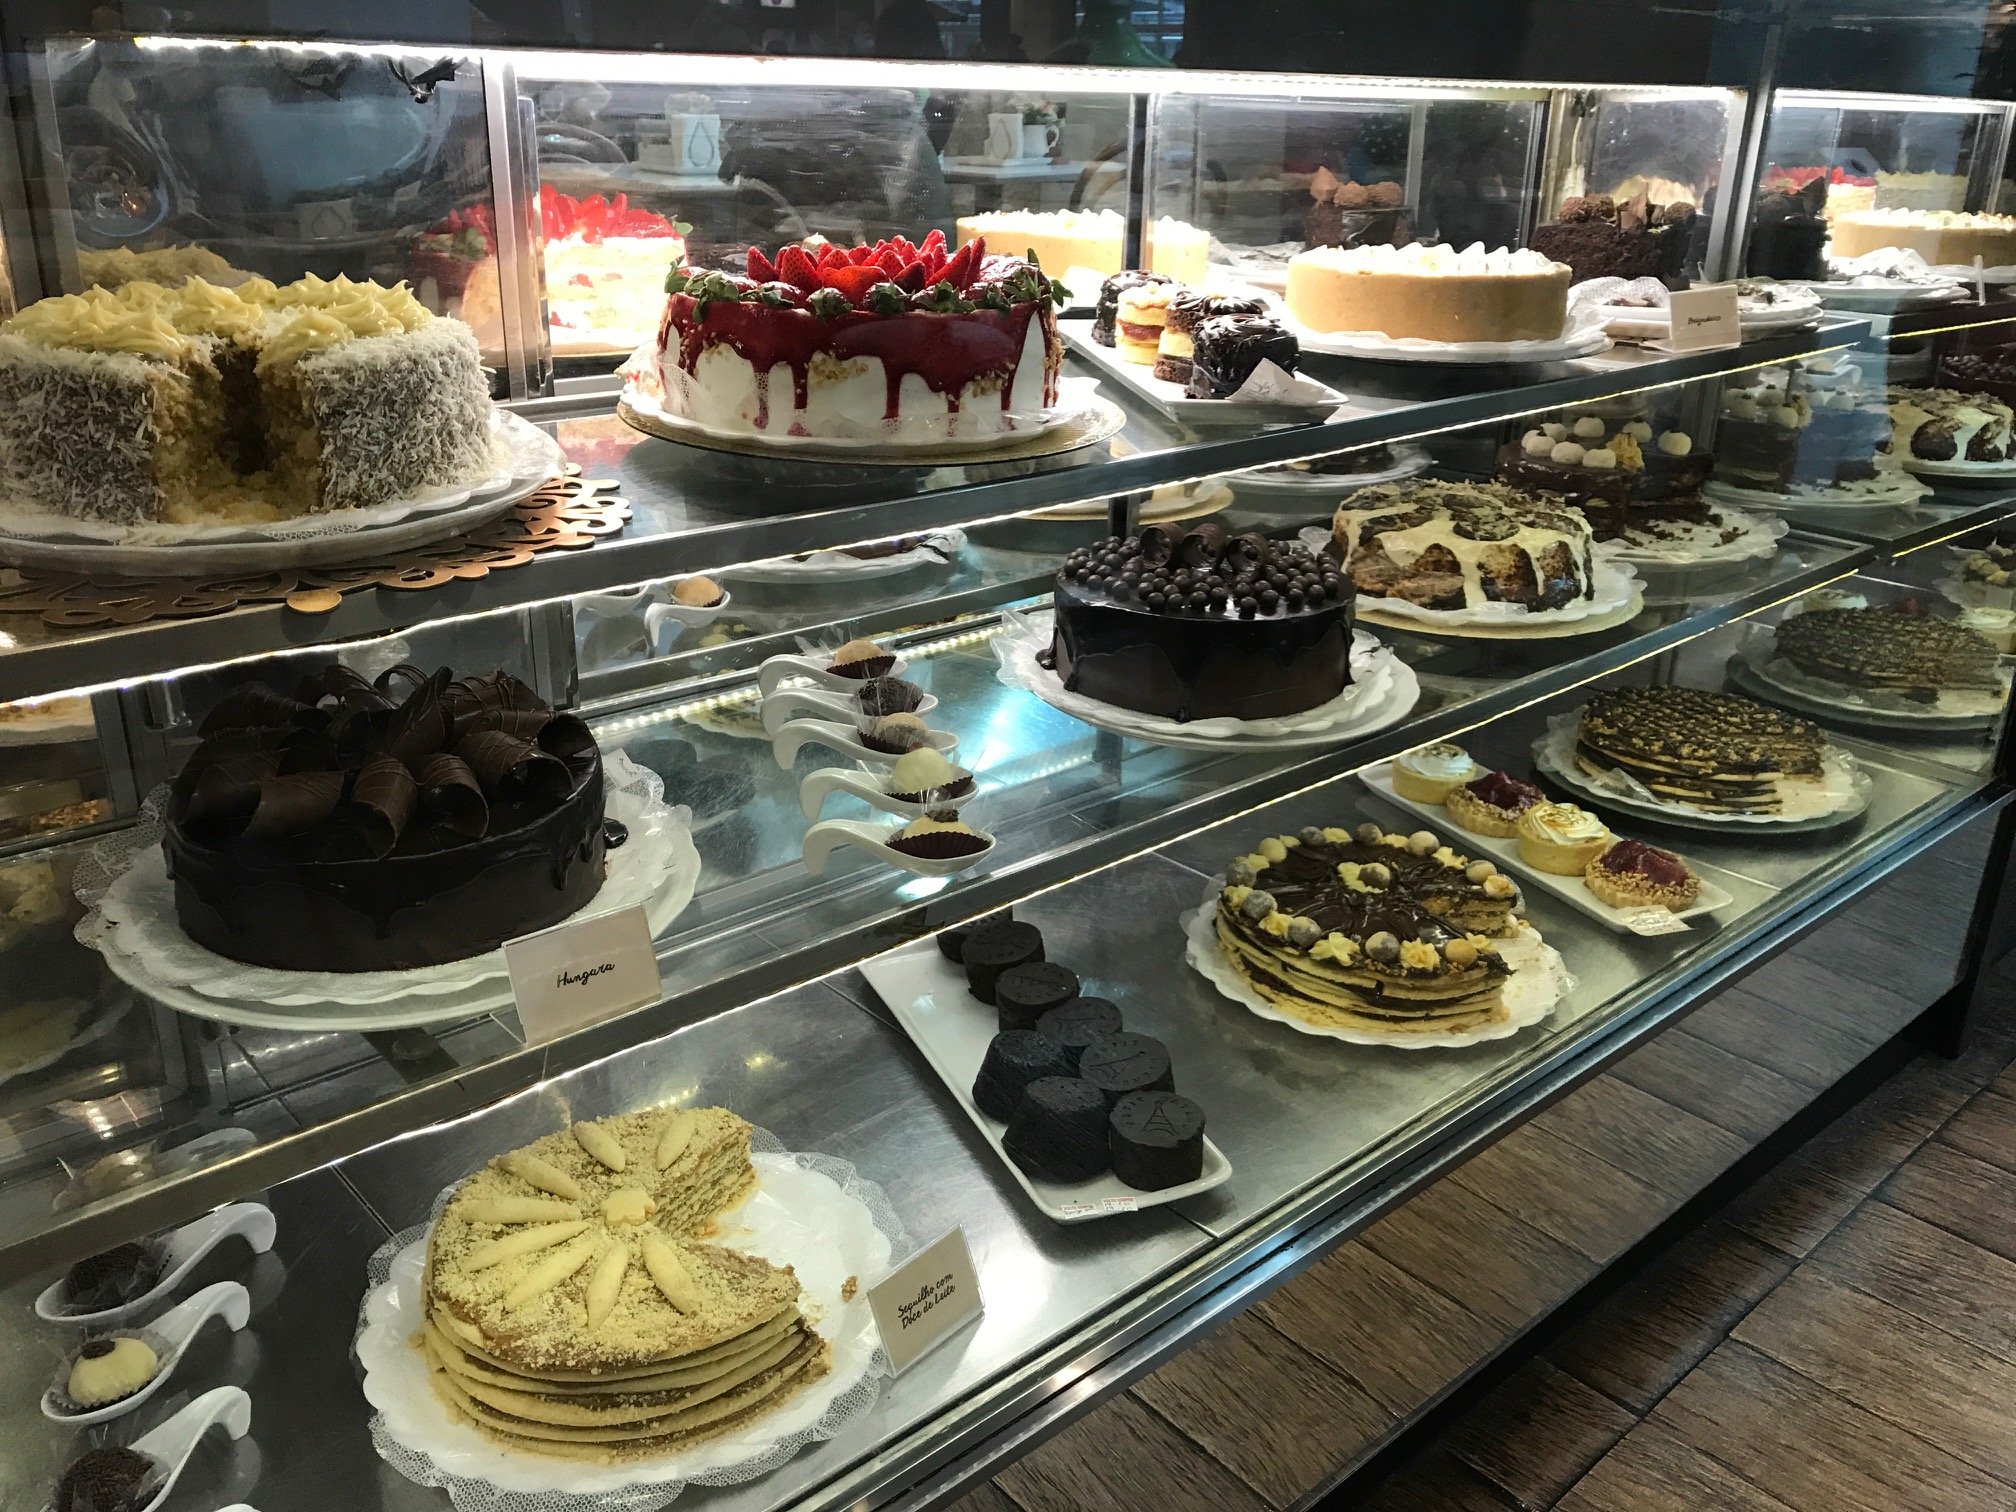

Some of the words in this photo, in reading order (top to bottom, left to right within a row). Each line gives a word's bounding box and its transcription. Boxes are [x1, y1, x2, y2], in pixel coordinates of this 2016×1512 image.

[556, 962, 616, 988] Hungara
[897, 1285, 935, 1318] Sequilho
[936, 1273, 953, 1290] com
[902, 1310, 923, 1330] Doce
[923, 1300, 934, 1313] de
[934, 1284, 956, 1305] Leite
